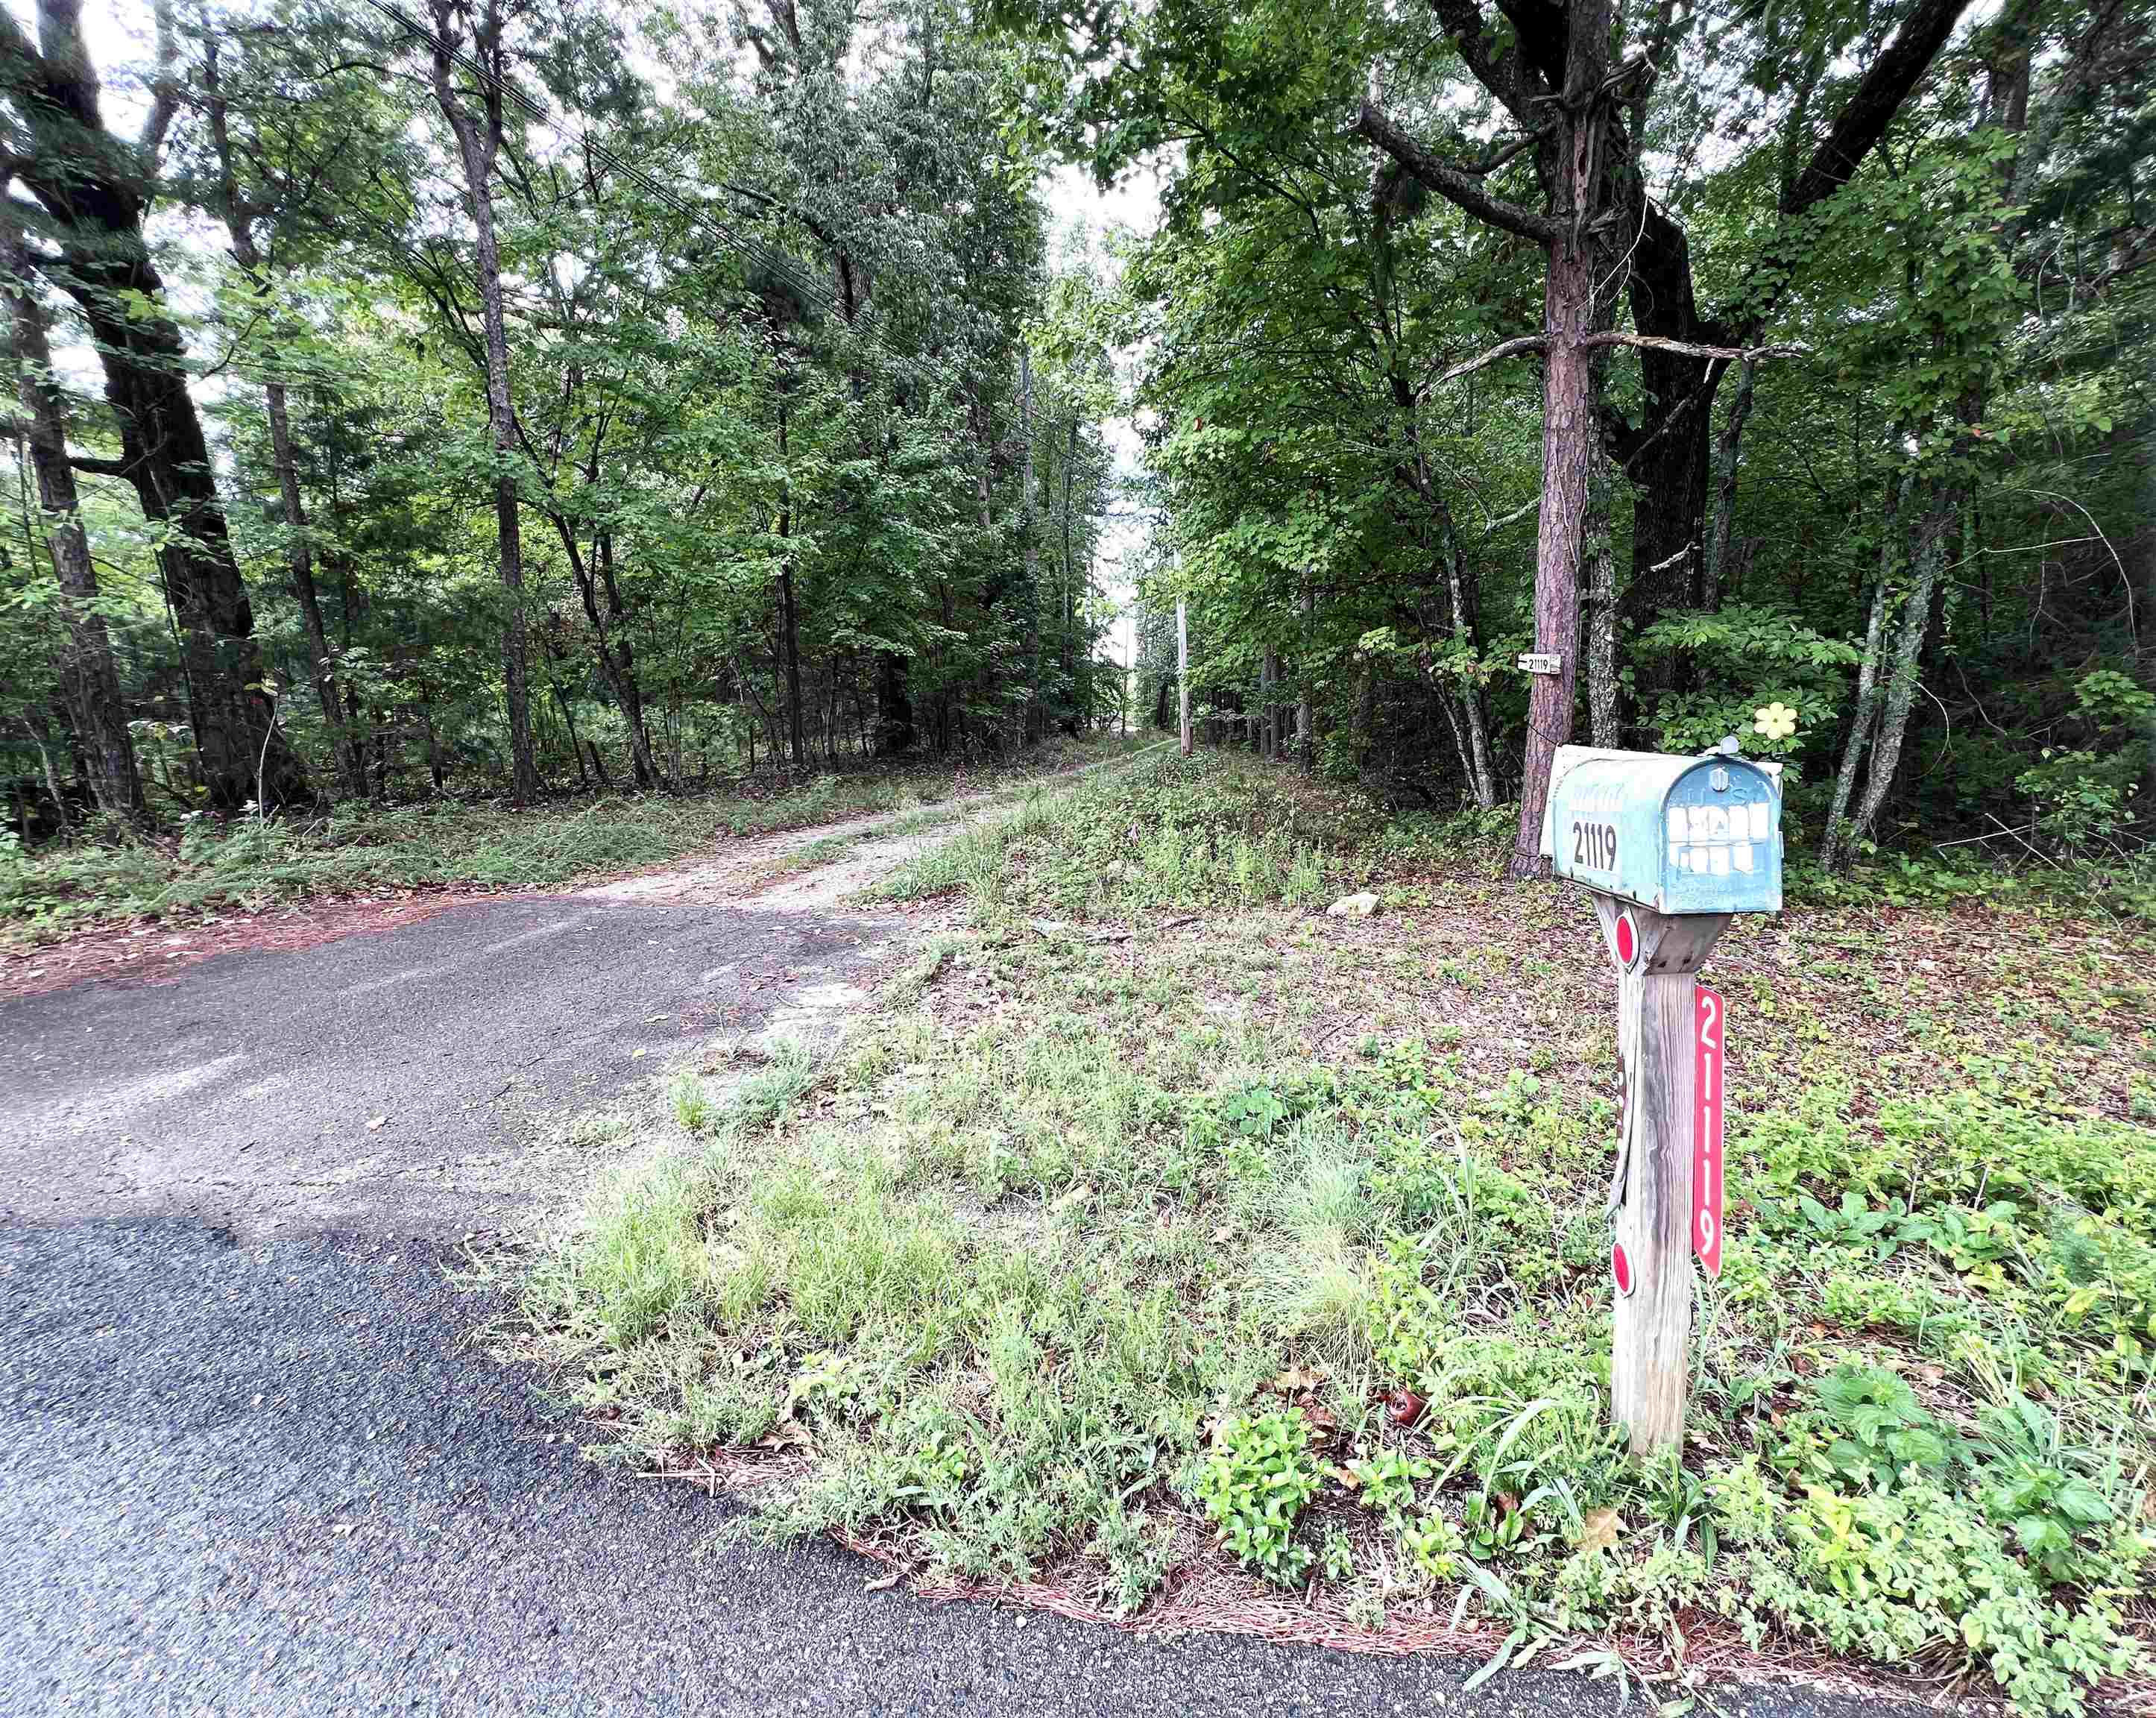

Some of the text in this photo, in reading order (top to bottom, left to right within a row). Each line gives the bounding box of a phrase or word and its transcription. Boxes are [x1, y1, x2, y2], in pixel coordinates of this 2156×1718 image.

[1528, 659, 1548, 670] 2119
[1572, 822, 1617, 871] 2119
[1700, 995, 1716, 1254] 2119
